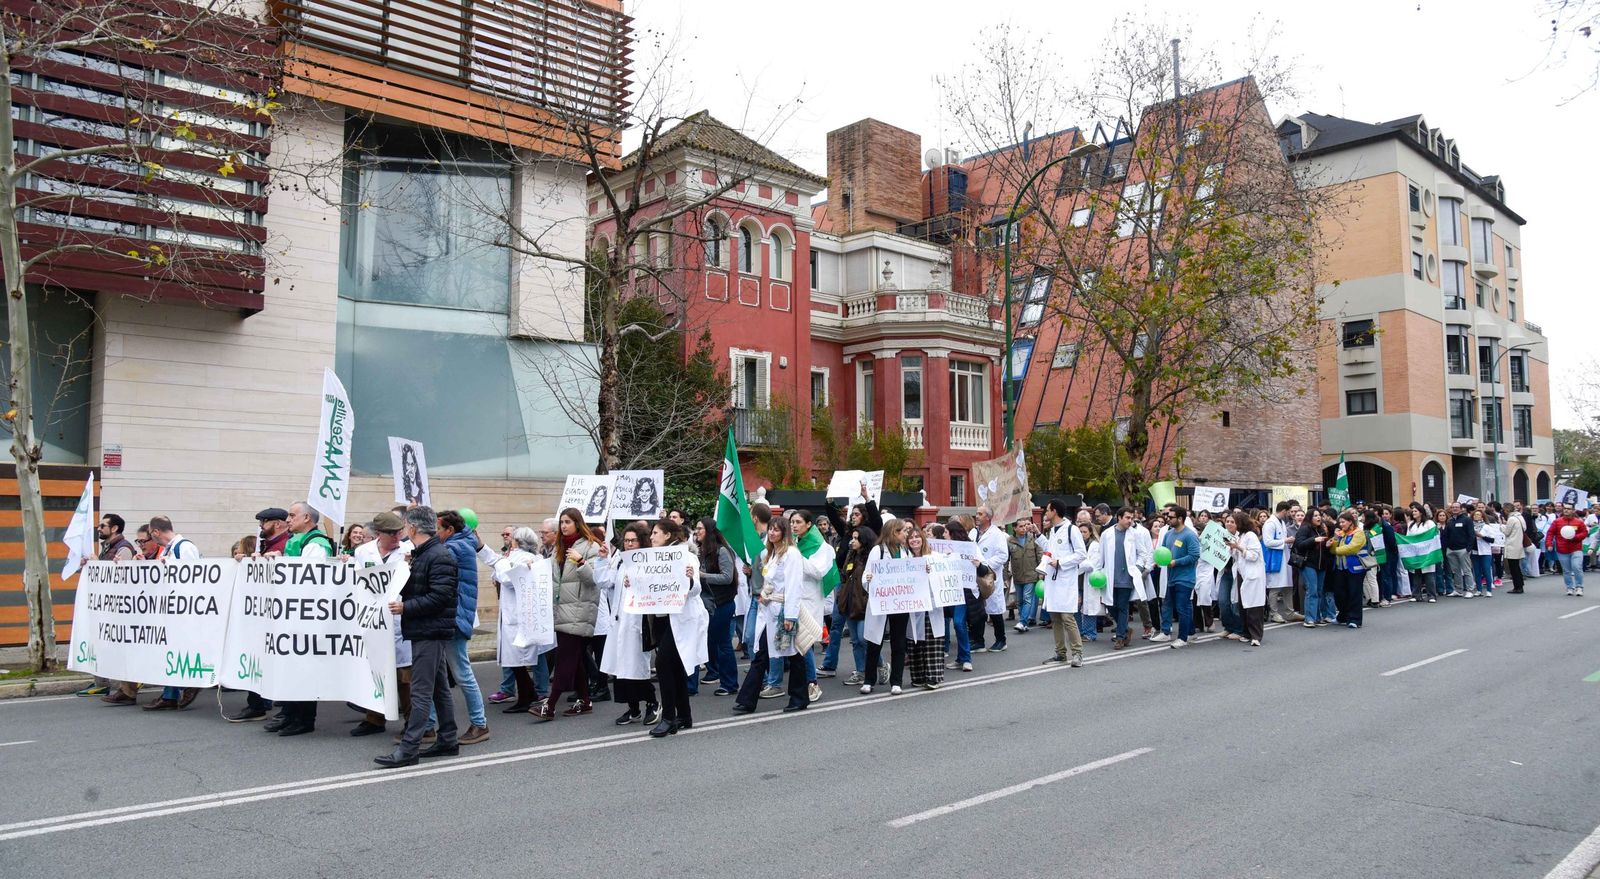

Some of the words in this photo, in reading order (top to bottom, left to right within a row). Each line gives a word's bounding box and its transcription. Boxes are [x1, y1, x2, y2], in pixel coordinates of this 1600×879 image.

[632, 552, 648, 562] CON
[655, 551, 682, 561] TALENTO
[88, 566, 99, 582] POR
[101, 566, 113, 583] UN
[114, 565, 160, 584] ESTATUTO
[164, 564, 221, 584] PROPIO
[247, 564, 264, 583] POR
[644, 564, 672, 574] VOCACIÓN
[649, 581, 680, 592] PENSIÓN
[876, 585, 914, 597] AGUANTAMOS
[94, 594, 102, 611] LA
[104, 590, 157, 614] PROFESIÓN
[159, 590, 218, 615] MÉDICA
[245, 596, 257, 616] DE
[880, 601, 889, 612] EL
[99, 622, 103, 639] Y
[104, 623, 167, 645] FACULTATIVA
[166, 651, 203, 679] SMA
